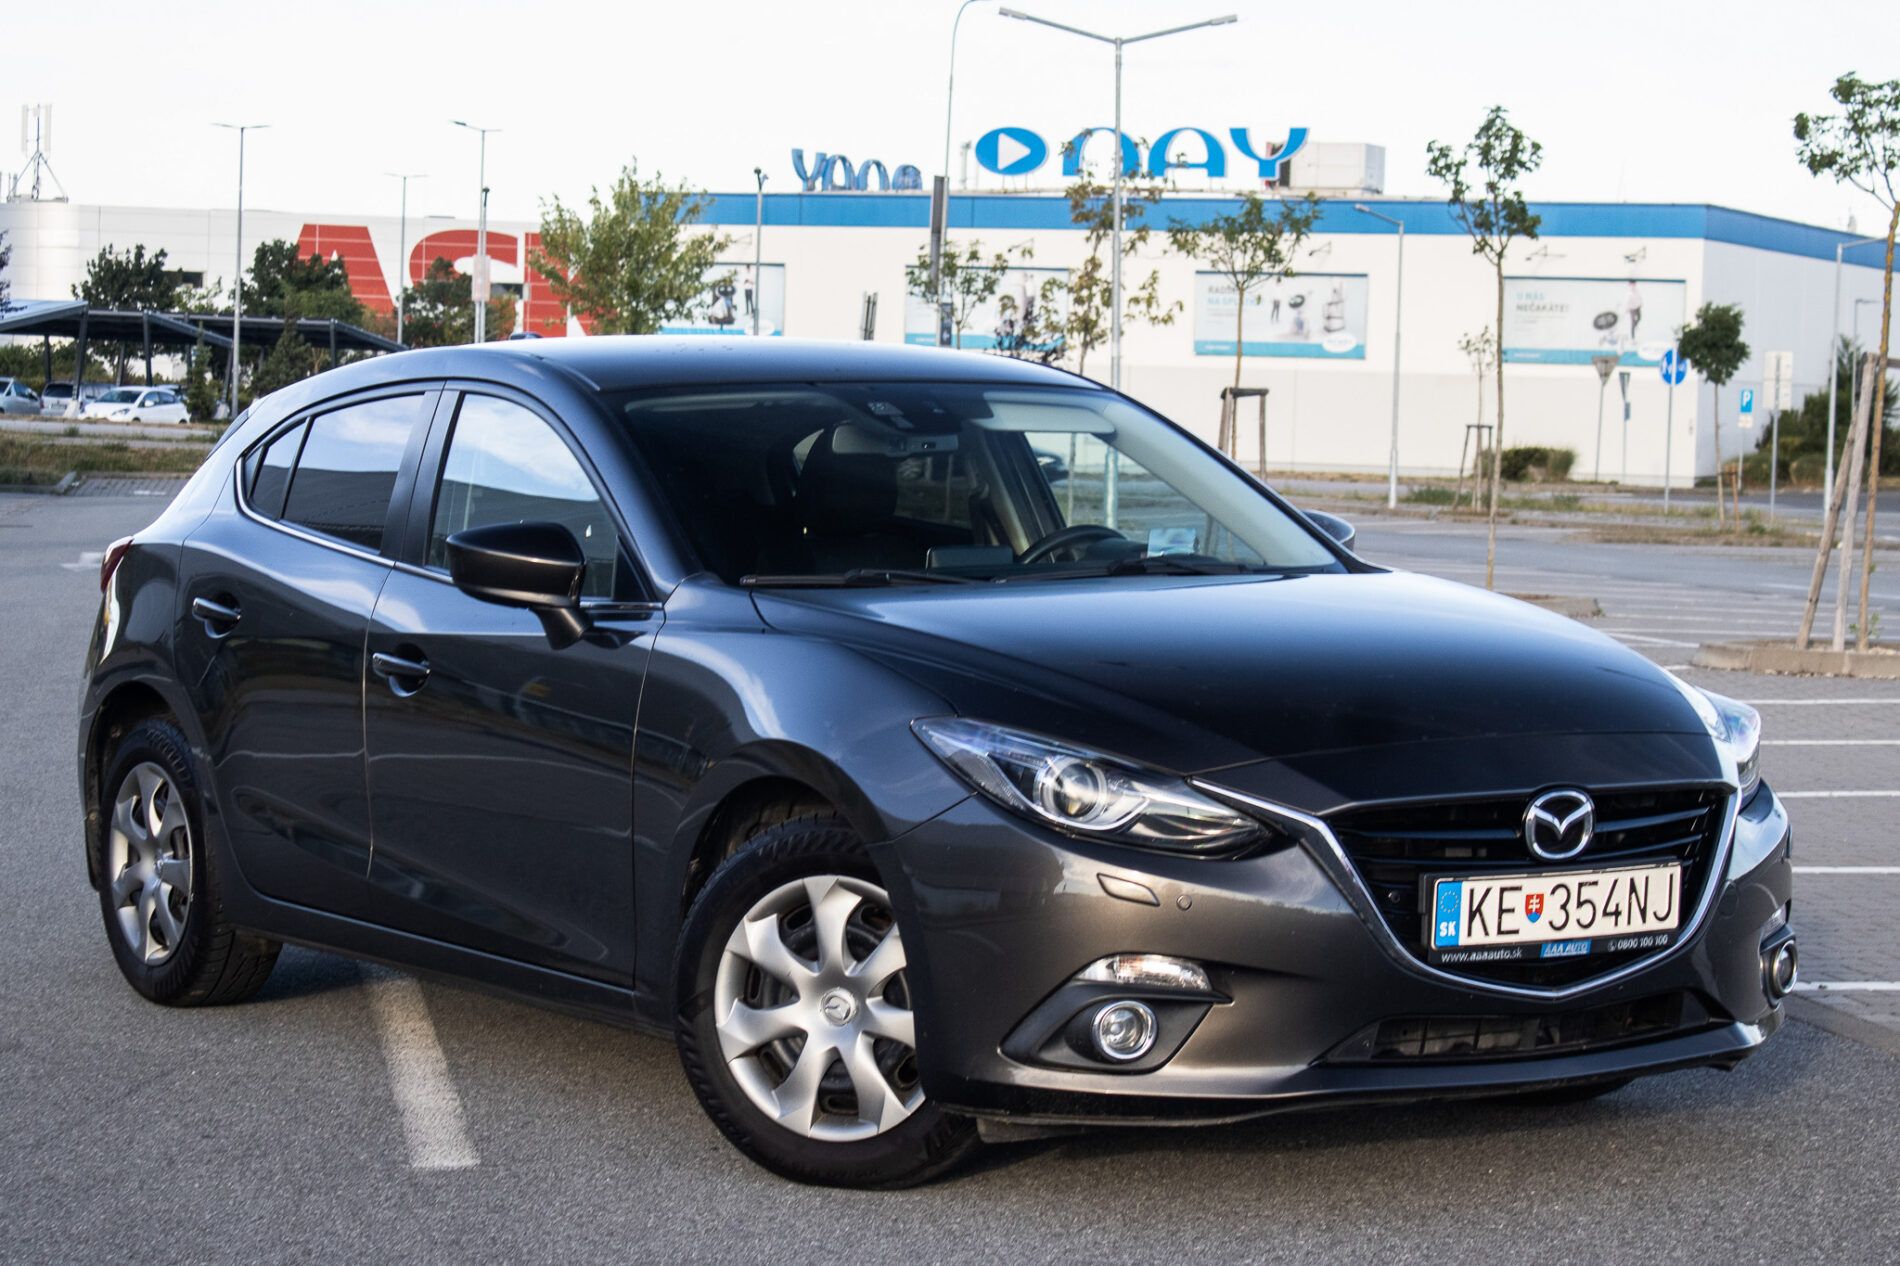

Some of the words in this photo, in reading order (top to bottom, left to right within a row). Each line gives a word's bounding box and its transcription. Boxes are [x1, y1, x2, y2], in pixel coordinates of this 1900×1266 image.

[1467, 886, 1523, 938] KE
[1548, 873, 1674, 931] 354NJ
[1439, 921, 1456, 937] SK
[1544, 944, 1565, 956] AAA
[1566, 942, 1588, 955] AUTO
[1617, 938, 1639, 950] 0800
[1641, 936, 1654, 948] 100
[1655, 934, 1668, 946] 100
